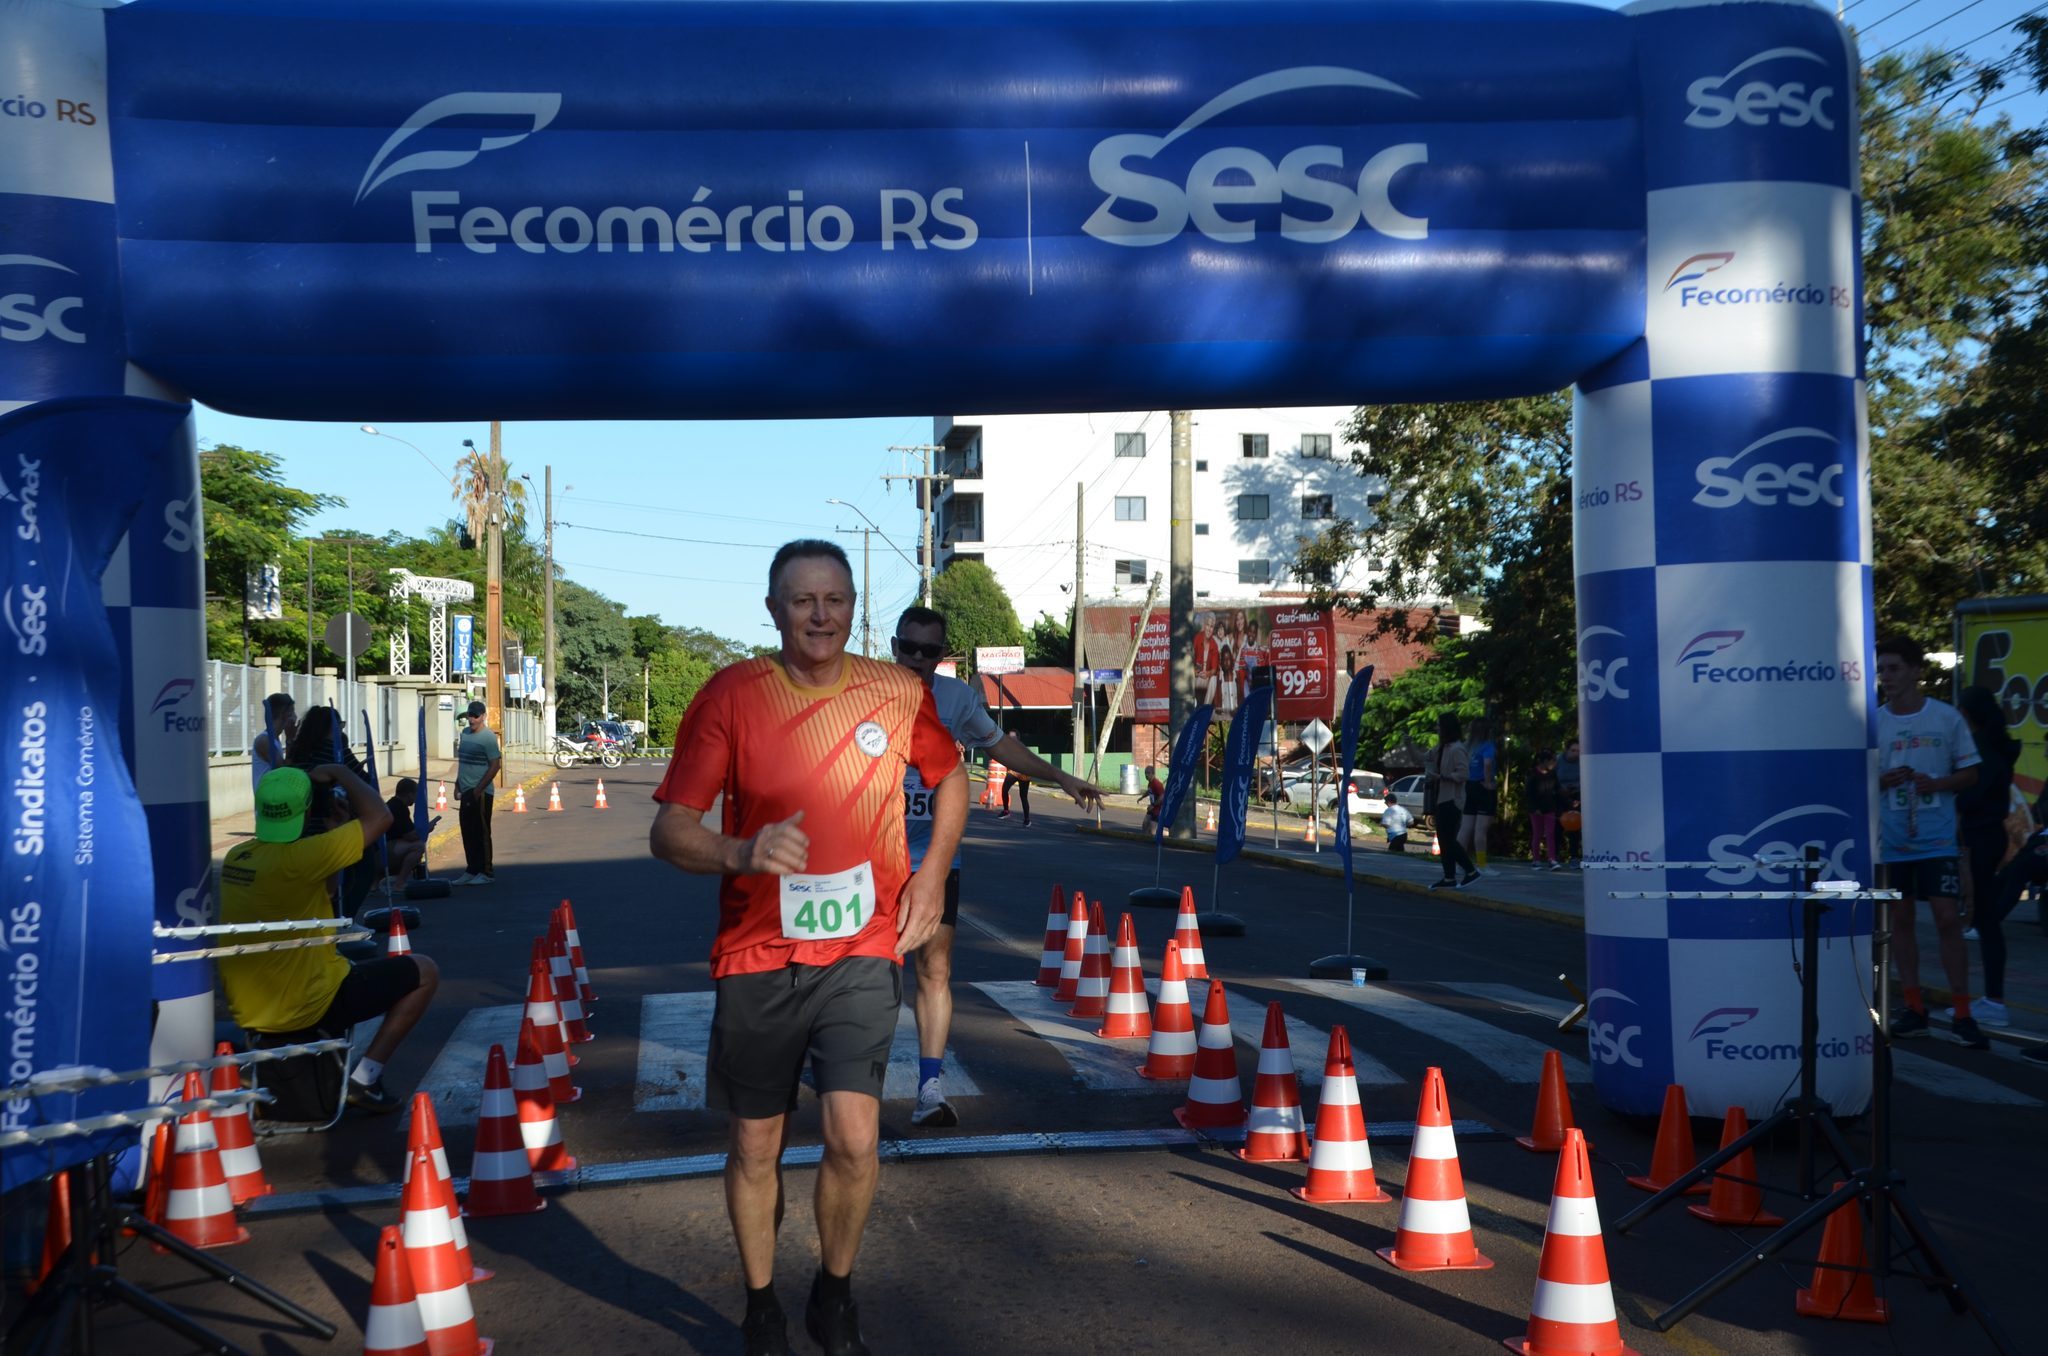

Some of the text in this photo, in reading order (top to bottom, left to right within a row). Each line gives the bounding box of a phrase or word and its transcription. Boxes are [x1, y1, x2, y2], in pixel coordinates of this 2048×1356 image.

[0, 95, 97, 126] cio RS
[1684, 76, 1834, 130] Sesc
[1081, 132, 1429, 247] Sesc
[410, 185, 979, 254] Fecomércio RS
[1681, 281, 1850, 308] Fecomércio RS
[0, 293, 87, 343] sc
[1615, 480, 1643, 503] RS
[1692, 456, 1845, 508] Sesc
[18, 584, 47, 656] Sesc
[458, 633, 470, 671] URI
[1284, 638, 1302, 647] MEGA
[1692, 660, 1861, 683] Fecomércio RS
[15, 700, 48, 856] Sindicatos
[75, 705, 95, 866] Sistema Comércio
[11, 901, 42, 943] RS
[794, 893, 862, 934] 401
[1706, 1034, 1873, 1060] Fecomrcio RS
